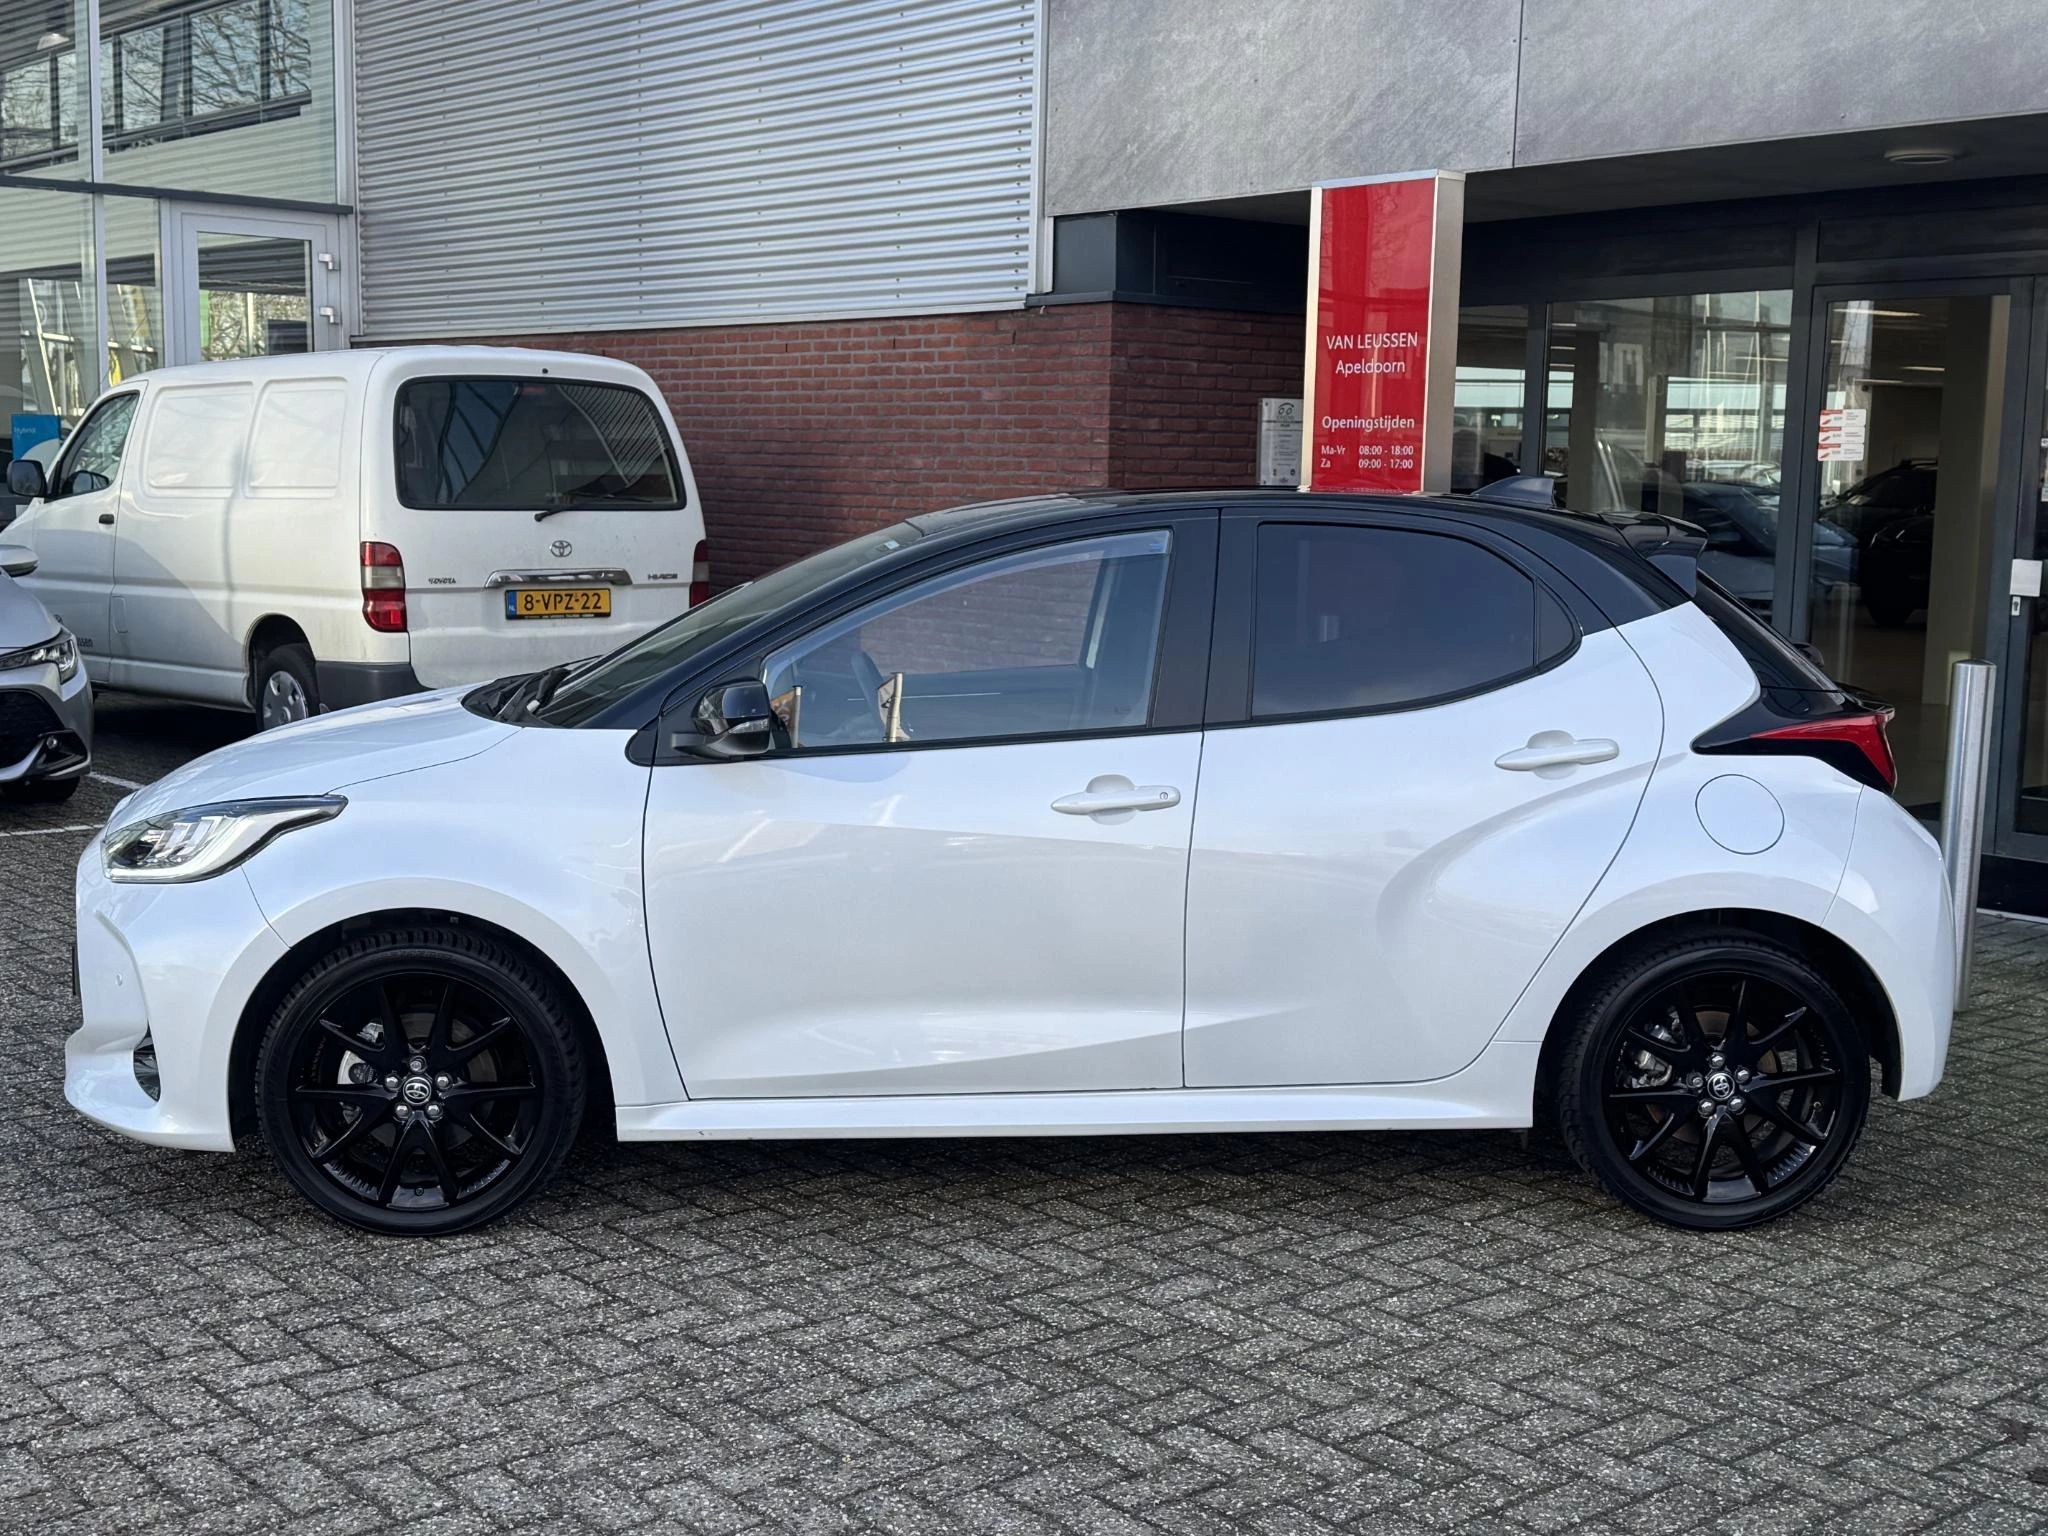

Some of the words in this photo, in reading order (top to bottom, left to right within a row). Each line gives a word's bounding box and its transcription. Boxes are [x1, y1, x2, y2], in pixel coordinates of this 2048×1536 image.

[1326, 334, 1354, 350] VAN
[1357, 331, 1418, 349] LEUSSEN
[1335, 358, 1406, 378] Apeldoorn
[1321, 415, 1416, 433] Openingstijden
[1320, 444, 1346, 456] Ma-Vr
[1358, 445, 1383, 456] 08:00
[1390, 445, 1414, 456] 18:00
[1320, 458, 1331, 469] Za
[1358, 459, 1382, 469] 09:00
[1389, 458, 1414, 469] 17:00
[523, 592, 602, 612] 8-VPZ-22
